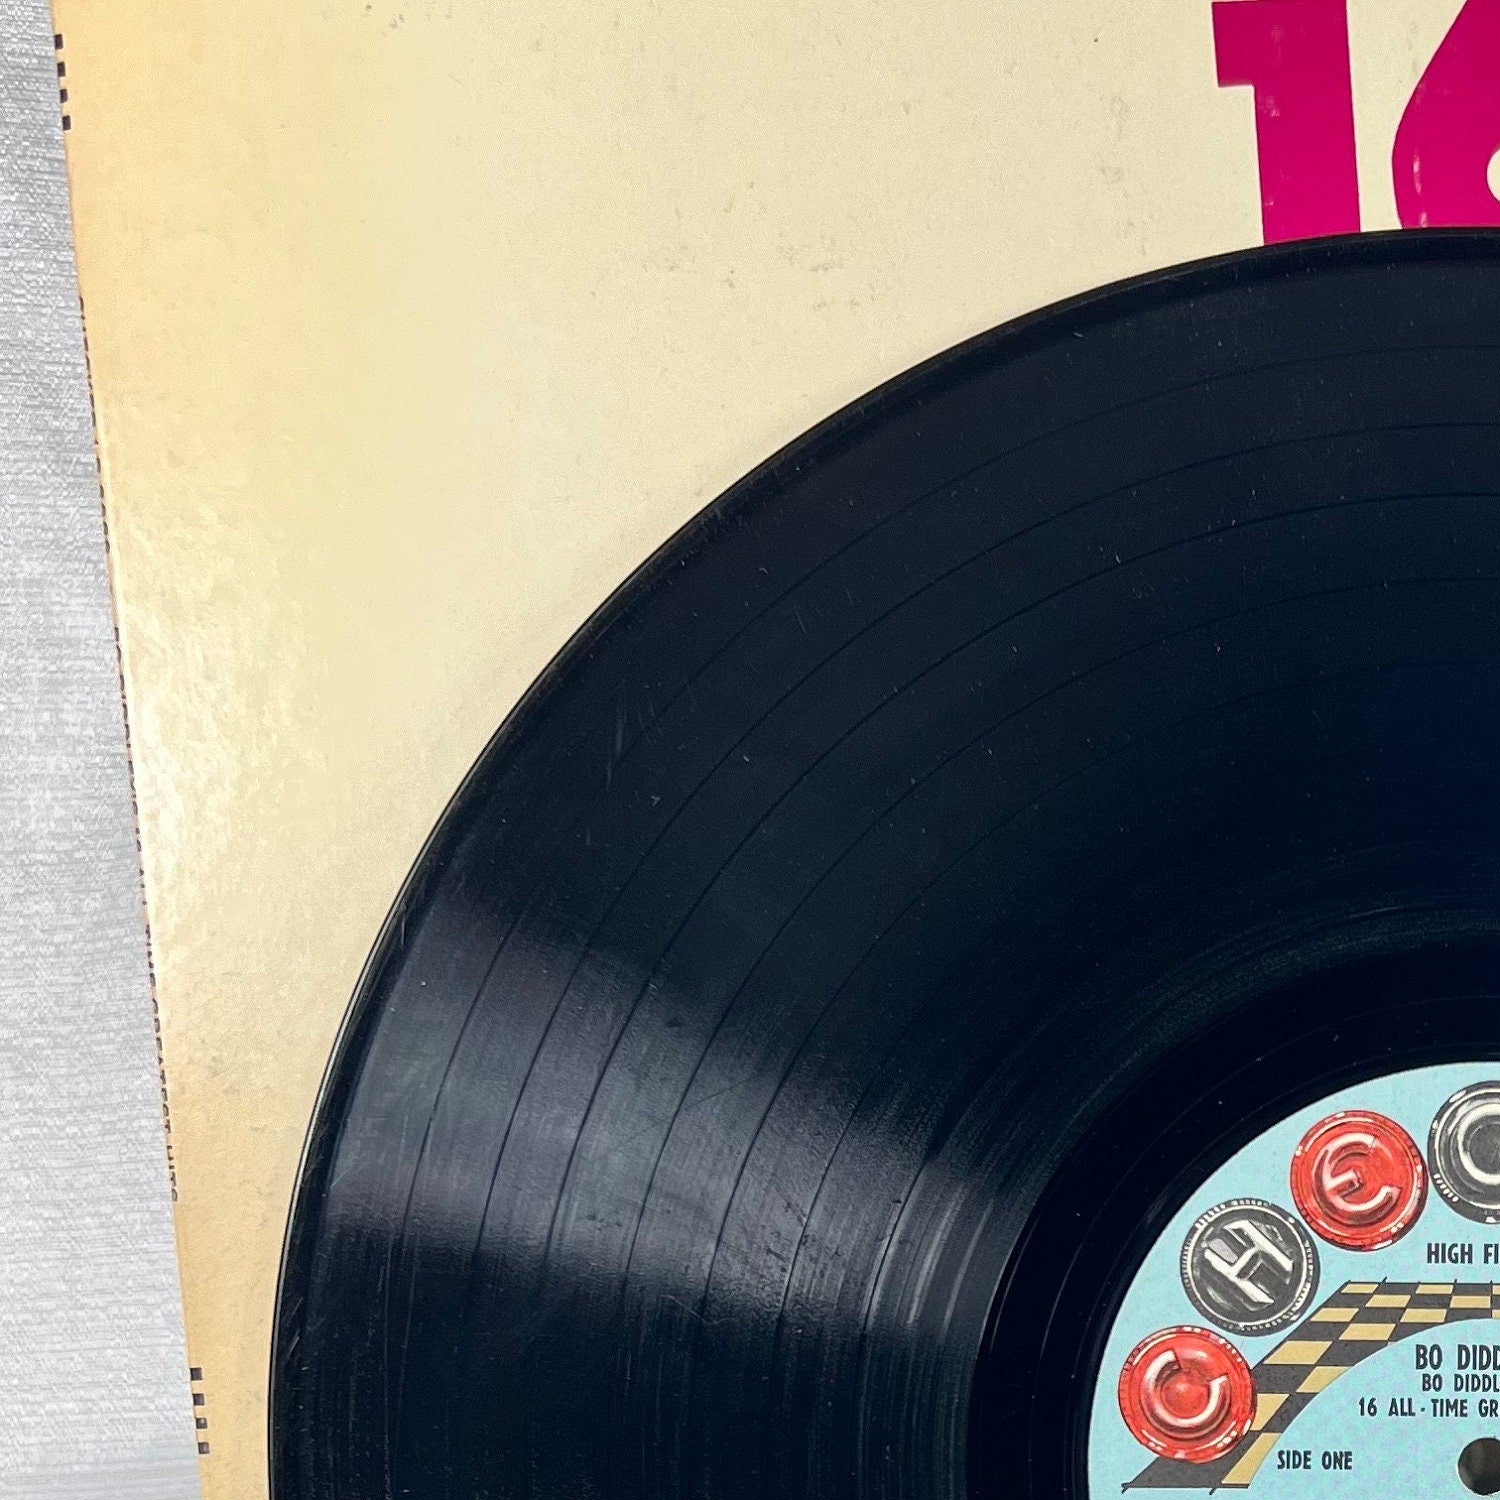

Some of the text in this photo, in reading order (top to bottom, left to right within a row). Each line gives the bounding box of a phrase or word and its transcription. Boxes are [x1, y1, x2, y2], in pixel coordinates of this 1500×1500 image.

[1426, 1242, 1473, 1265] HIGH
[1415, 1343, 1443, 1371] BO
[1421, 1373, 1443, 1393] BO
[1358, 1396, 1378, 1417] 16
[1277, 1449, 1353, 1471] SIDE ONE
